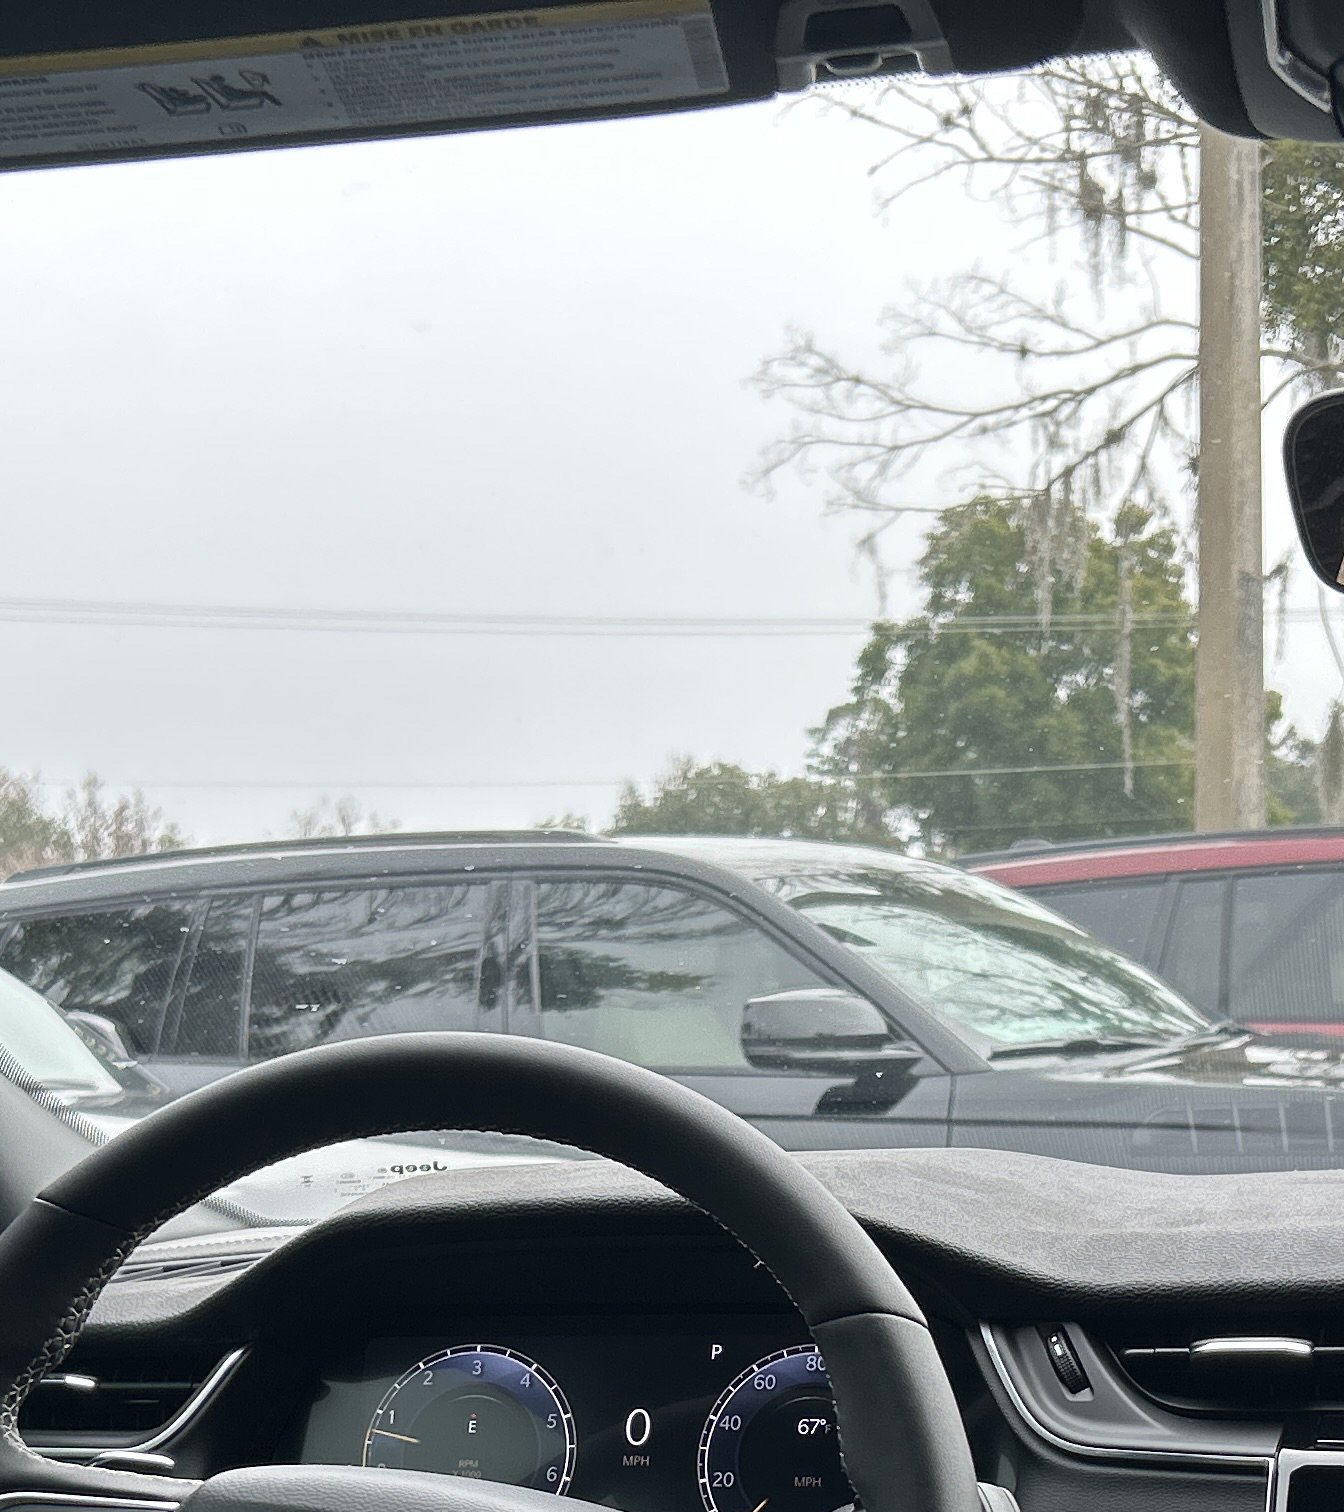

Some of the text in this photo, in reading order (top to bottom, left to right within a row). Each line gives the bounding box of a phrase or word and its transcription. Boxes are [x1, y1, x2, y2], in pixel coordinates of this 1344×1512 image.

[408, 23, 443, 40] EN
[451, 15, 539, 35] GARDE
[711, 1344, 723, 1360] P
[472, 1360, 482, 1375] 3
[423, 1370, 434, 1386] 2
[520, 1373, 531, 1388] 4
[753, 1374, 777, 1390] 60
[389, 1410, 396, 1425] 1
[546, 1414, 557, 1429] 5
[719, 1415, 742, 1431] 40
[468, 1420, 477, 1434] E
[625, 1408, 651, 1446] 0
[458, 1459, 479, 1468] RPM
[622, 1455, 650, 1467] MPH
[546, 1466, 558, 1482] 6
[712, 1472, 735, 1488] 20
[794, 1476, 822, 1489] MPH
